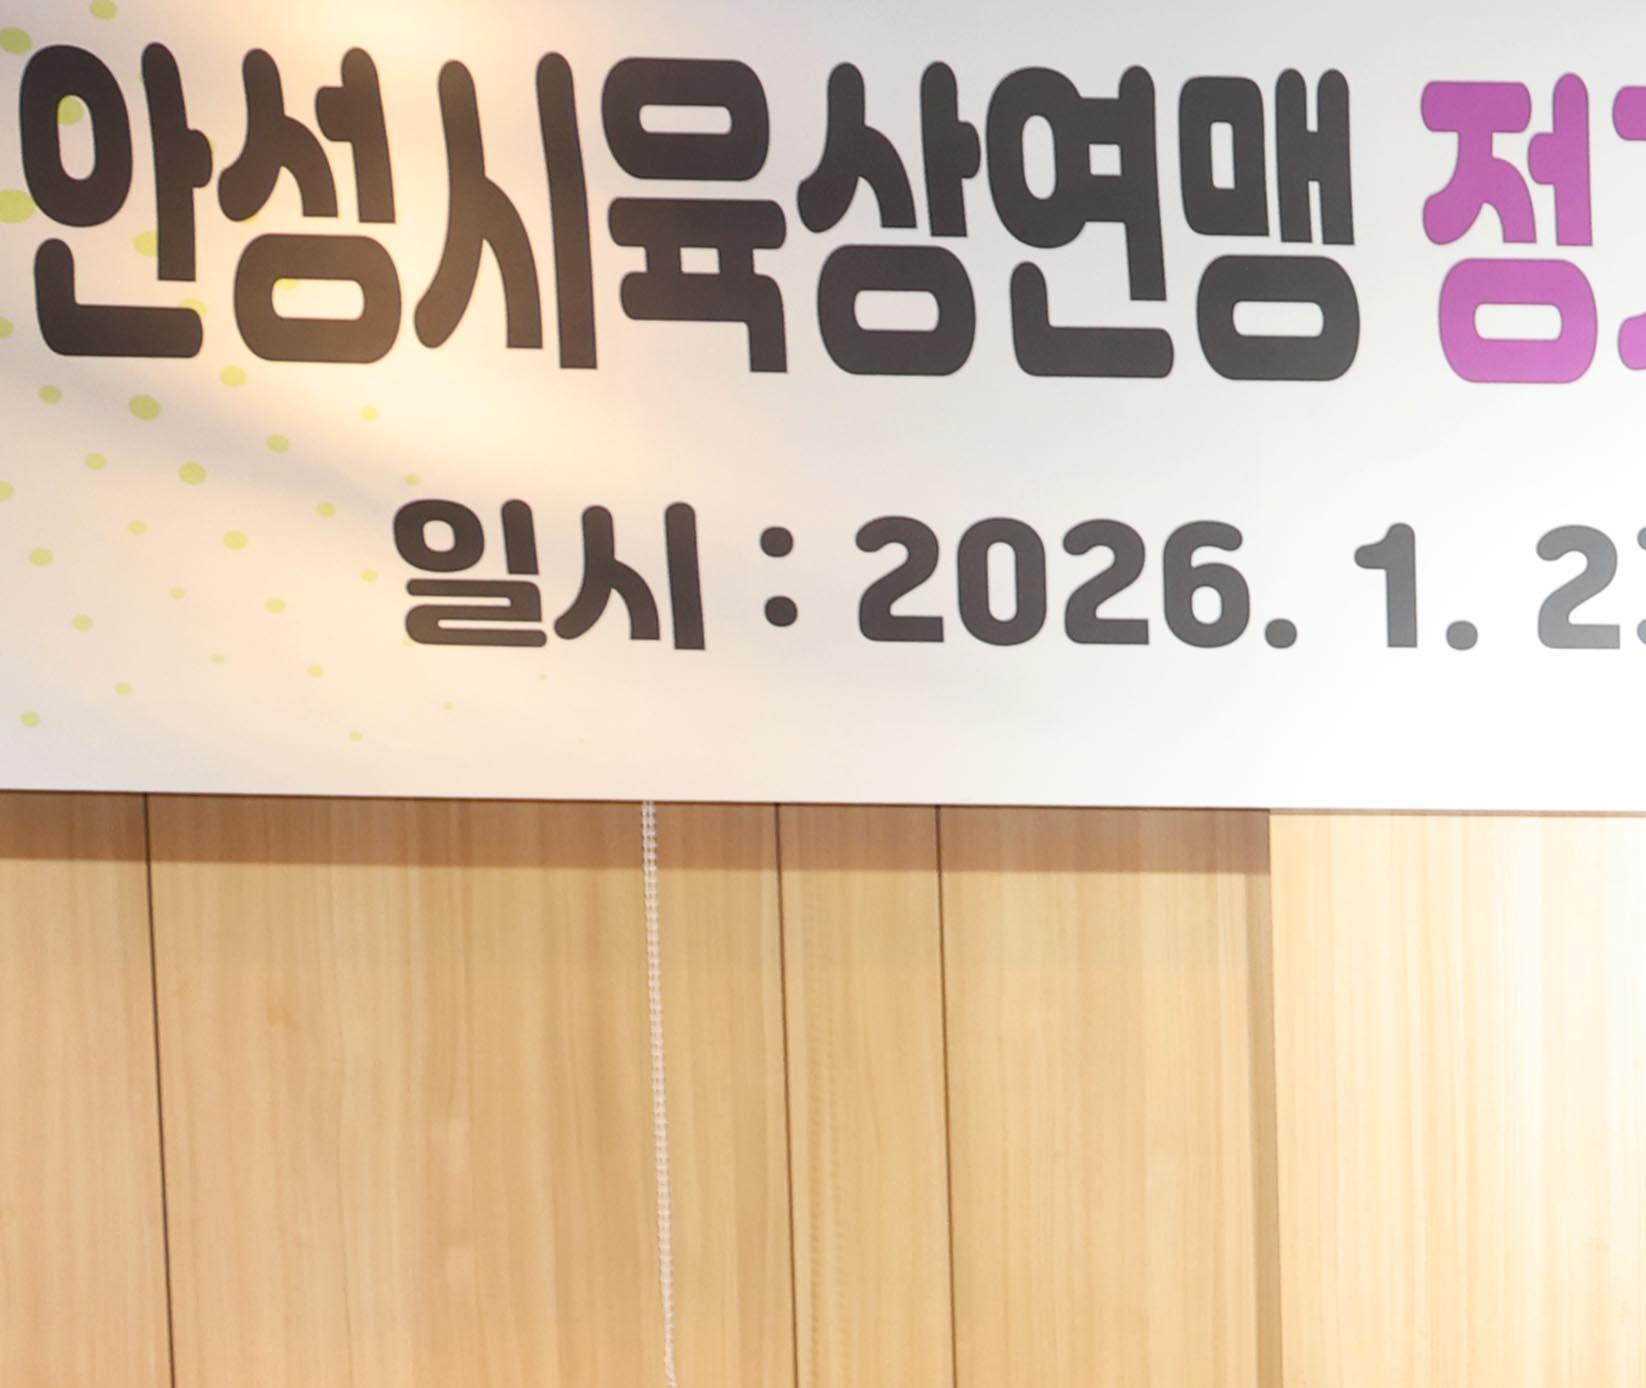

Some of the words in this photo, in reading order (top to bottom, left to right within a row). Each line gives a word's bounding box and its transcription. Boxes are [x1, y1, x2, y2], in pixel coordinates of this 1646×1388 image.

[20, 43, 1361, 382] 안성시육상연맹
[393, 498, 705, 650] 일시
[855, 516, 1297, 648] 2026.
[1355, 523, 1478, 652] 1.
